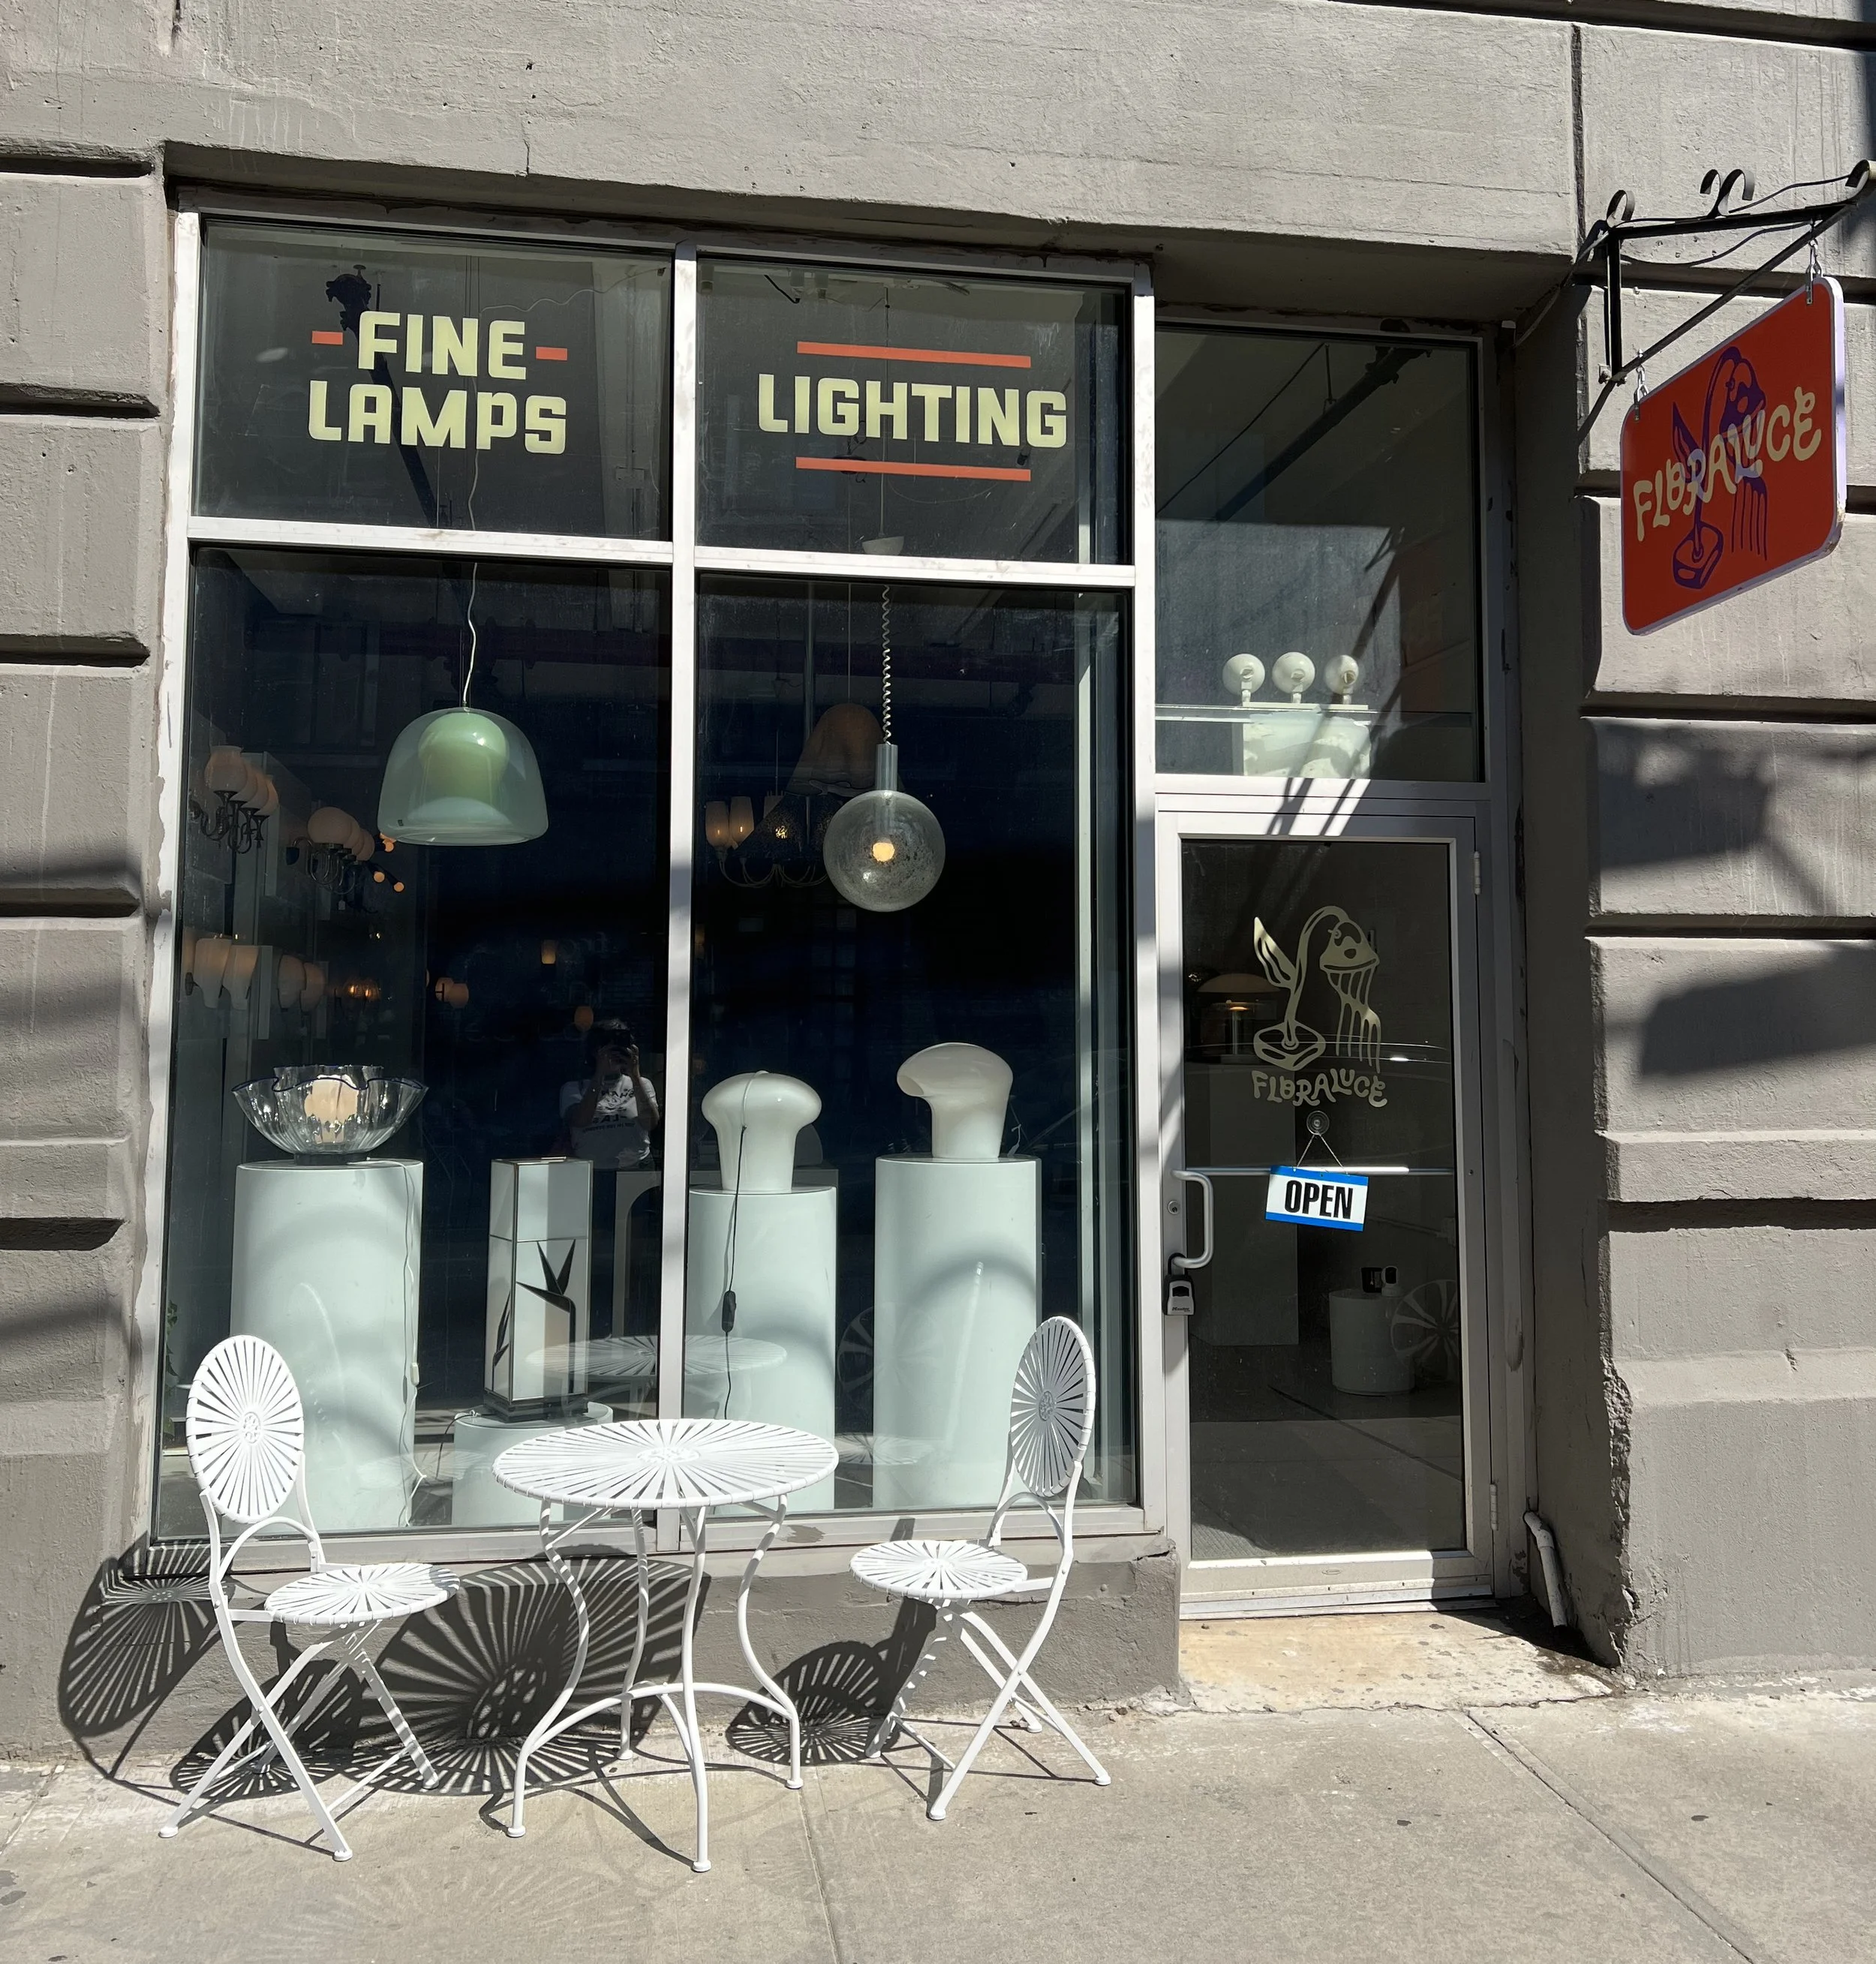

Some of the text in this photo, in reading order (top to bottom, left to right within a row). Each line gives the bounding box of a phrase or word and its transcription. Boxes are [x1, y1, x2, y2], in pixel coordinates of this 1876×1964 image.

[358, 311, 527, 380] FINE
[308, 380, 567, 455] LAMPS
[758, 374, 1066, 448] LIGHTING
[1285, 1180, 1354, 1220] OPEN
